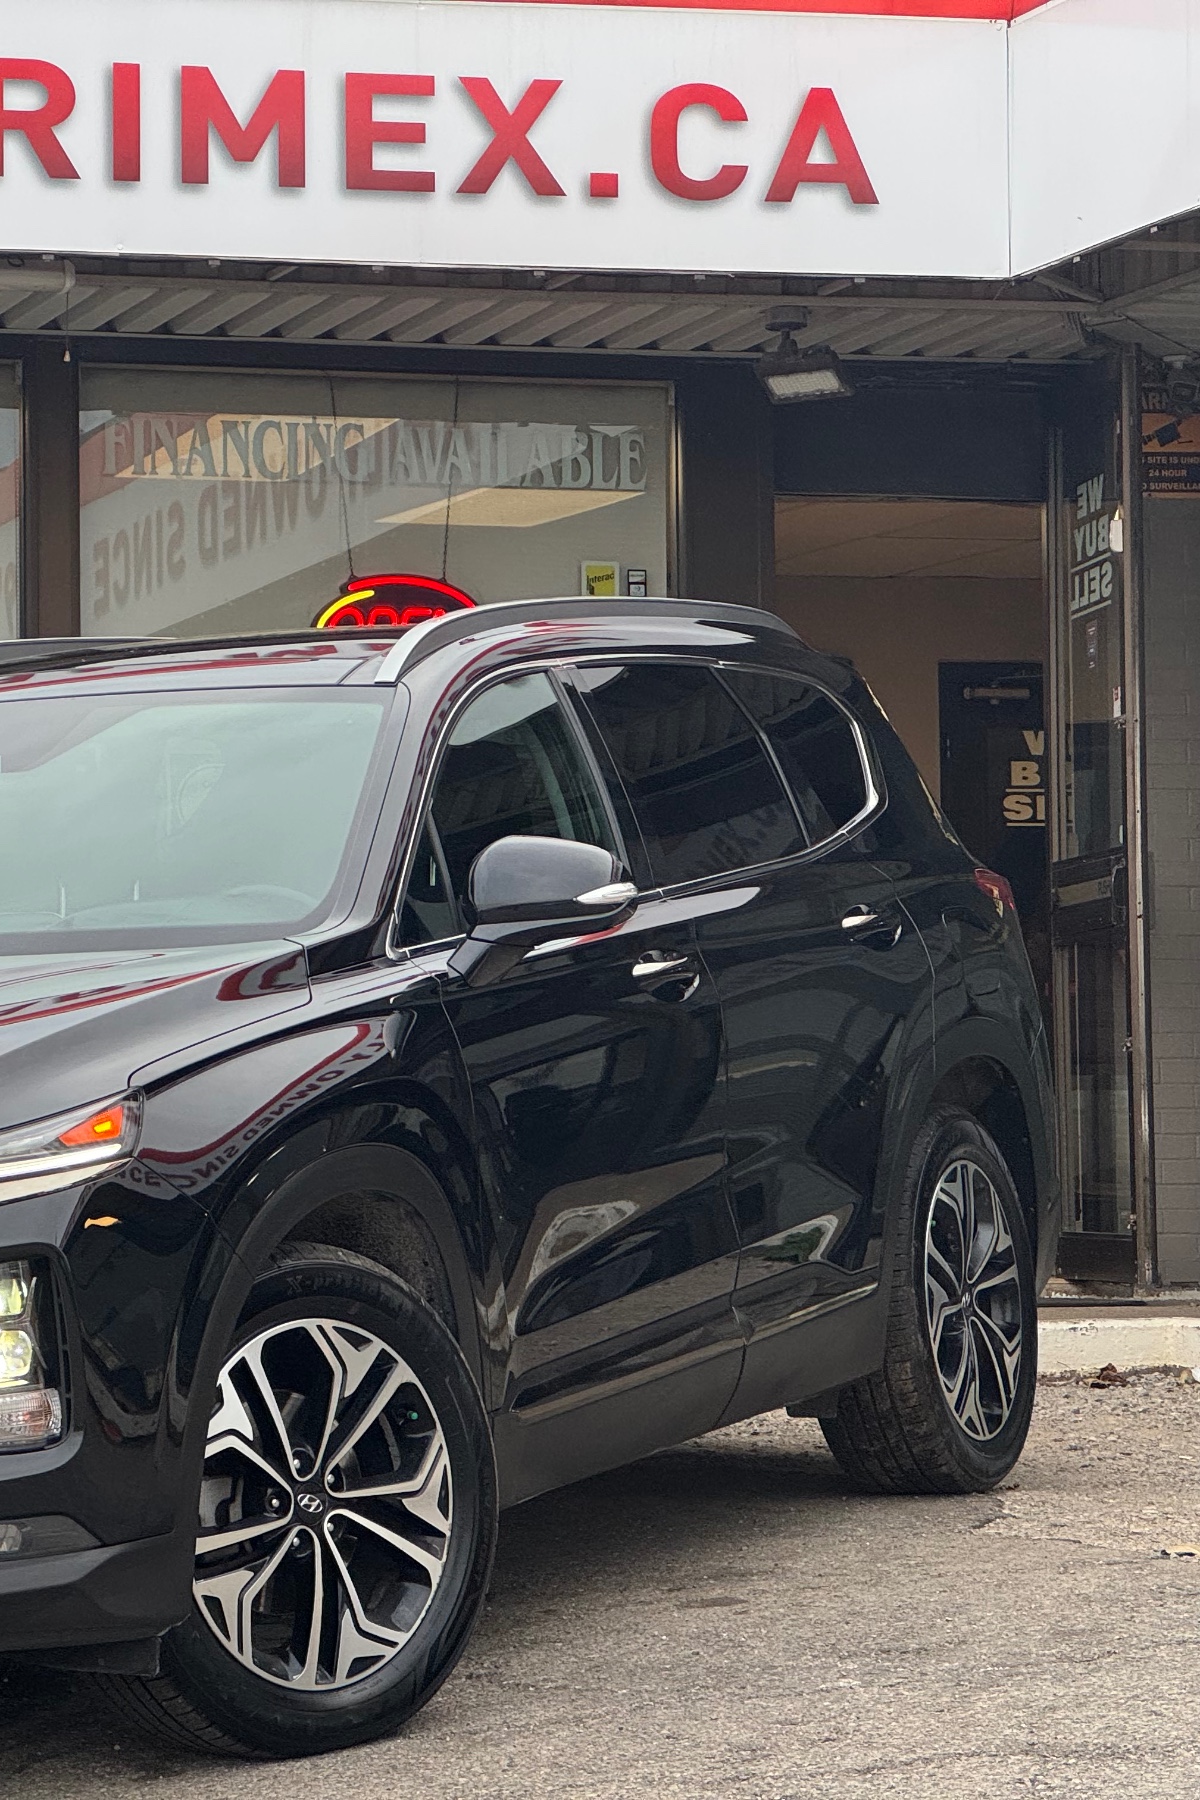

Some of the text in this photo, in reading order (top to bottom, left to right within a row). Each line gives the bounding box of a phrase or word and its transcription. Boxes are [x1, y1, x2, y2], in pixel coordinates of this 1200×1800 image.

[103, 418, 369, 483] FINANCING
[387, 424, 647, 491] AVAILABLE
[1148, 469, 1188, 478] 24 HOUR
